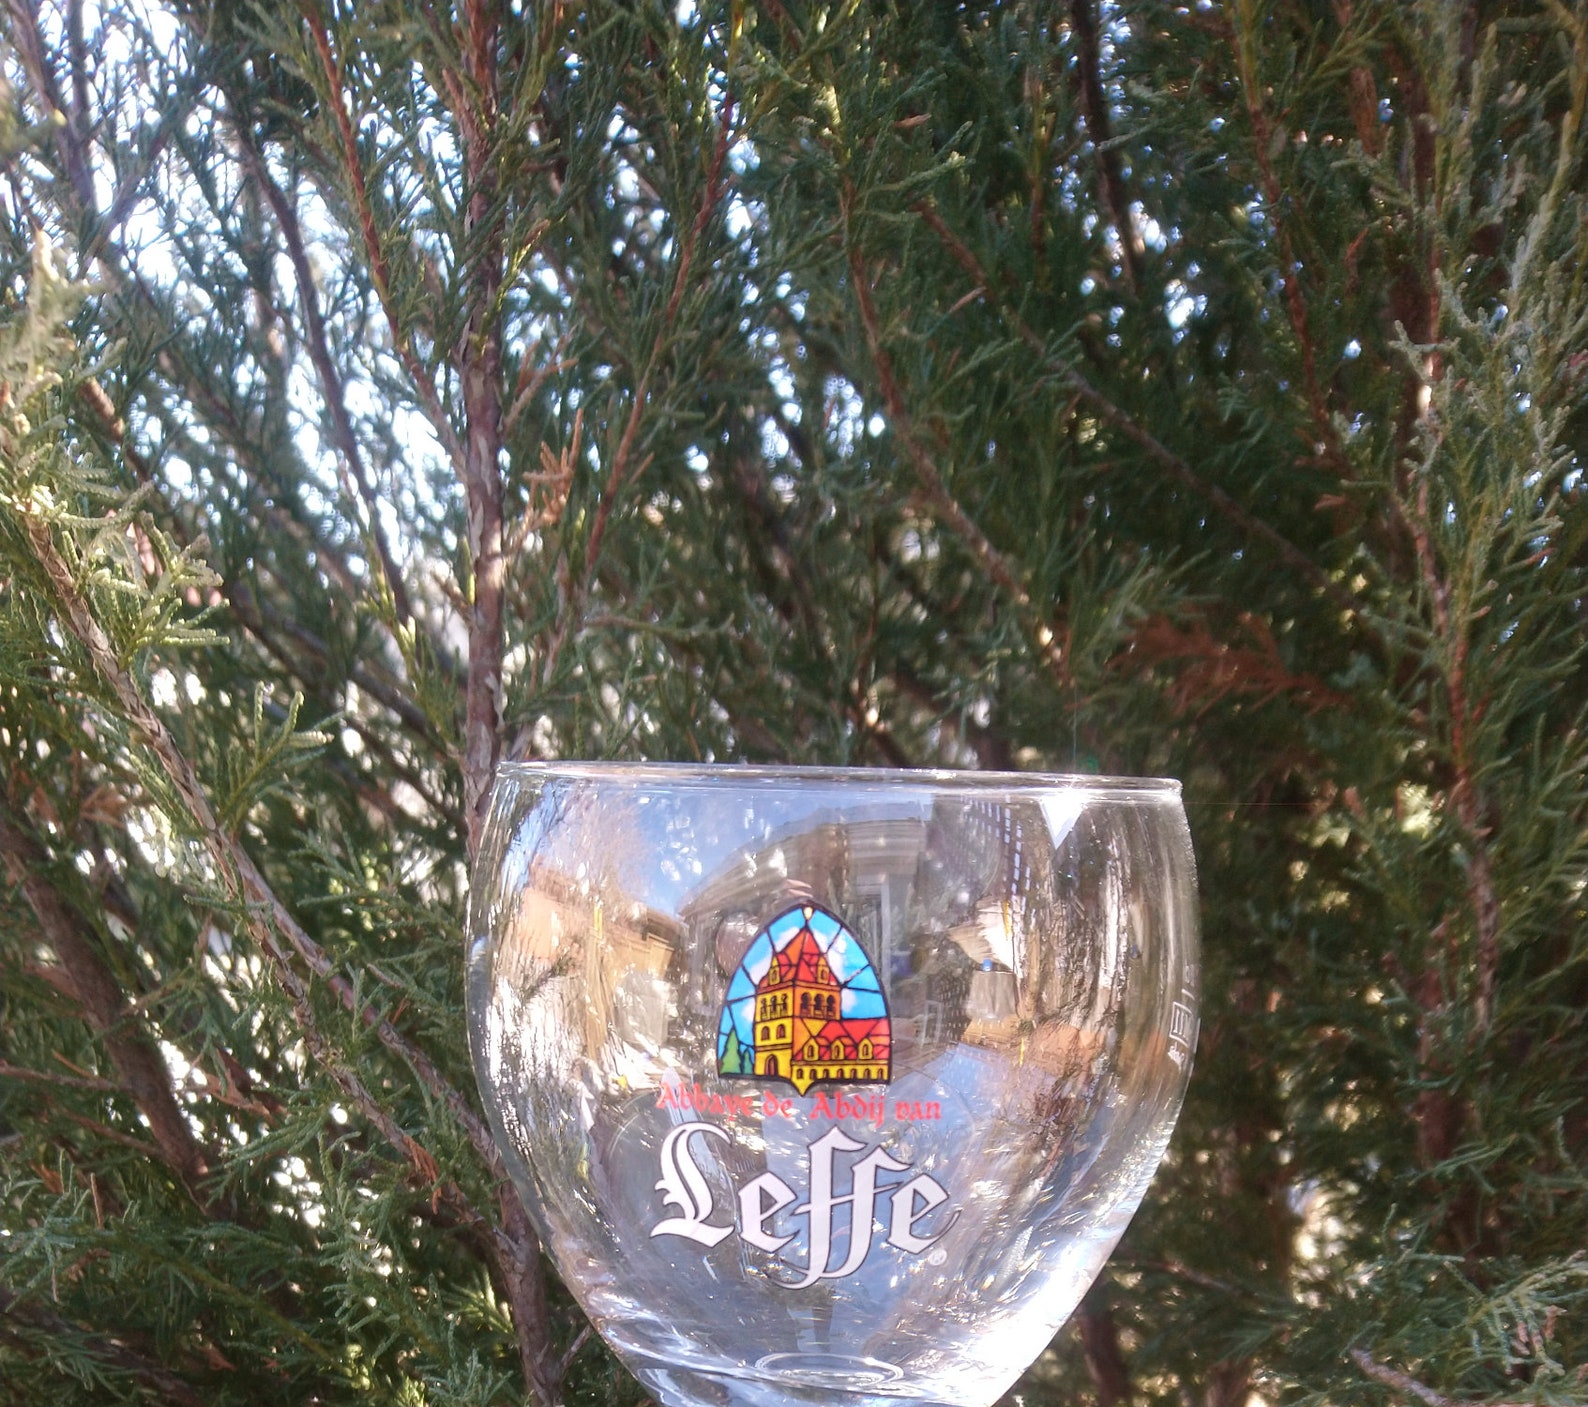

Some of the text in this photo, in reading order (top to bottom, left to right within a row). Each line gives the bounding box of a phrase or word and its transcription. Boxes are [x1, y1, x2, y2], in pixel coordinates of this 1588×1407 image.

[656, 1082, 942, 1128] Abbaye de Abdij van
[650, 1121, 963, 1290] Leffe
